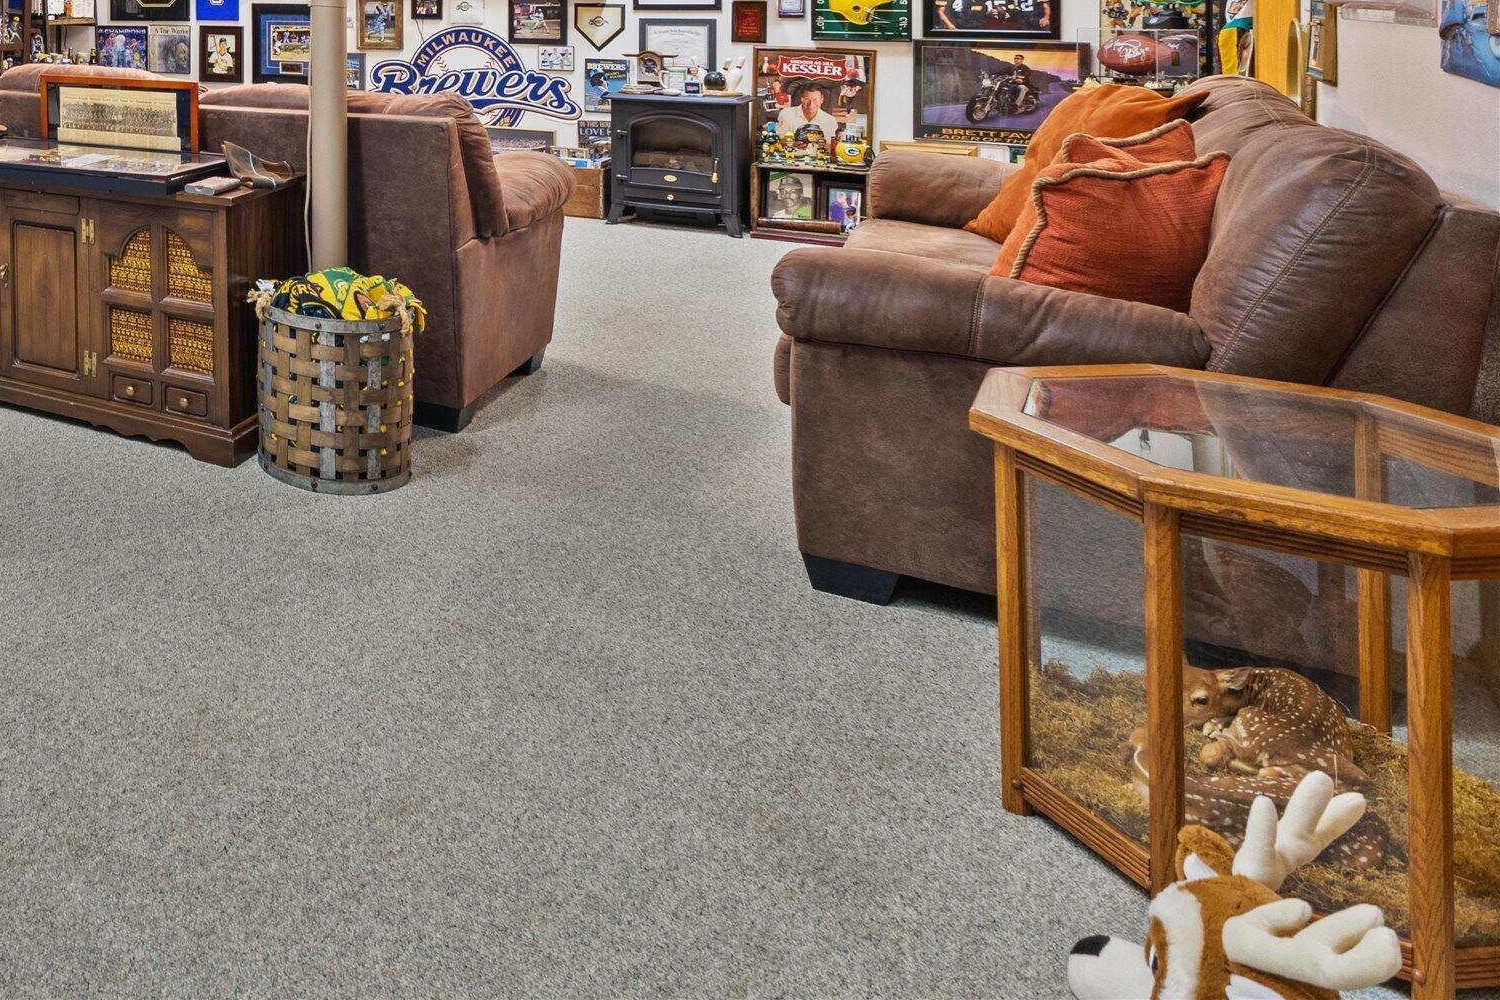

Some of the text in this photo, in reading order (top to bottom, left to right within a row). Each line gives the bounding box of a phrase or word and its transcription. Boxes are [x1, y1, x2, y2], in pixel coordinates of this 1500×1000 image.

[416, 31, 517, 68] MILWAUKEE
[586, 63, 627, 71] BREWERS
[782, 63, 843, 76] KESSLER
[371, 60, 572, 111] Brewers
[580, 128, 605, 136] LOVE
[941, 128, 998, 138] BRETT
[923, 133, 981, 142] LEADER
